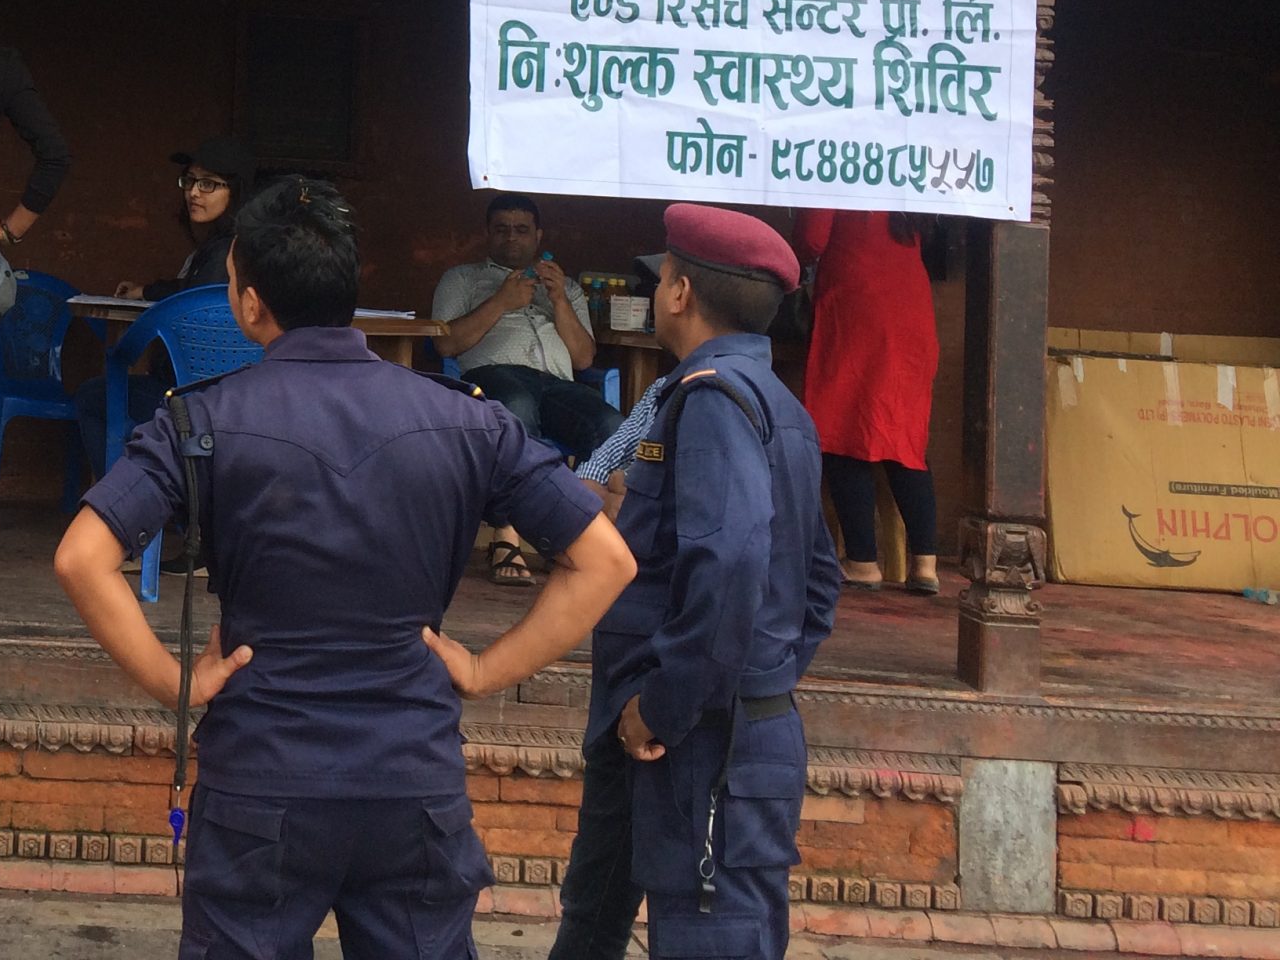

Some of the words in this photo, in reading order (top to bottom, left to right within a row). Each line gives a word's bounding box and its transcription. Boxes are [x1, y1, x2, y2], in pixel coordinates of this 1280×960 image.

[693, 48, 858, 110] स्वास्थ्य
[873, 41, 1001, 121] शिविर
[1171, 482, 1228, 497] Furniture)
[1230, 486, 1280, 498] Moulded
